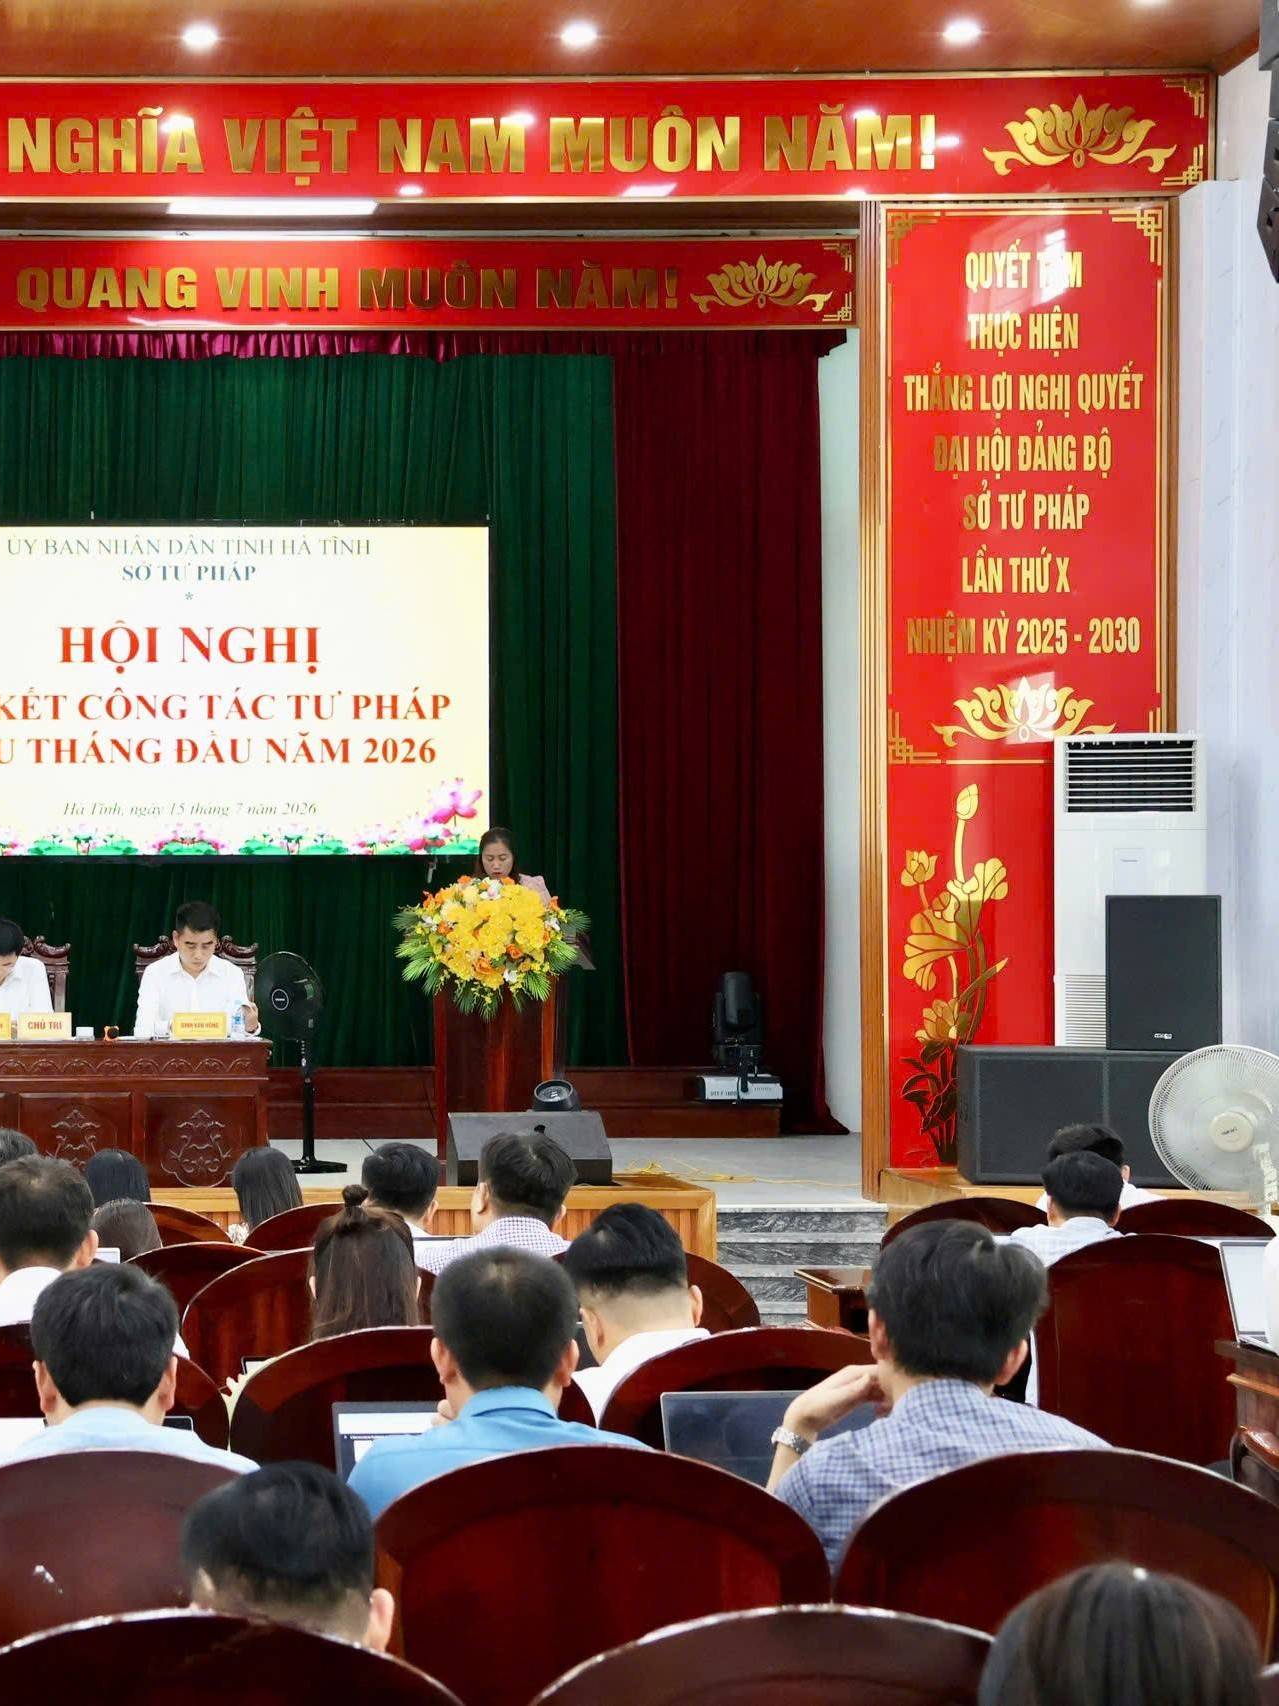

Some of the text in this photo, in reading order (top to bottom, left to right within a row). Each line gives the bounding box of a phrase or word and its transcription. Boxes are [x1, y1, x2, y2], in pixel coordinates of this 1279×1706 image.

[8, 106, 204, 174] NGHĨA
[223, 106, 357, 186] VIỆT
[378, 117, 526, 174] NAM
[549, 104, 740, 173] MUÔN
[763, 103, 936, 171] NĂM!
[16, 267, 198, 312] QUANG
[214, 267, 339, 310] VINH
[359, 259, 517, 310] MUÔN
[536, 261, 679, 310] NĂM!
[965, 239, 1031, 294] QUYẾT
[968, 305, 1079, 357] THỰC HIỆN
[904, 361, 1144, 419] THẮNG LỢI NGHỊ QUYẾT
[934, 419, 1112, 479] ĐẠI HỘI ĐẢNG BỘ
[963, 480, 1090, 530] SỞ TƯ PHÁP
[44, 539, 90, 555] BAN
[98, 534, 160, 555] NHÂN
[168, 534, 214, 555] DÂN
[962, 544, 1070, 593] LẦN THỨ X
[158, 562, 191, 581] TƯ
[197, 561, 257, 581] PHÁP
[59, 620, 320, 674] HỘI NGHỊ
[907, 610, 1141, 662] NHIỆM KỲ 2025 - 2030
[78, 687, 188, 720] CÔNG
[199, 687, 275, 720] TÁC
[287, 690, 342, 720] TƯ
[352, 687, 451, 720] PHÁP
[26, 731, 161, 764] THÁNG
[175, 731, 252, 764] ĐẦU
[265, 732, 350, 764] NĂM
[363, 737, 437, 763] 2026
[170, 803, 185, 816] 15
[281, 802, 318, 816] 2026
